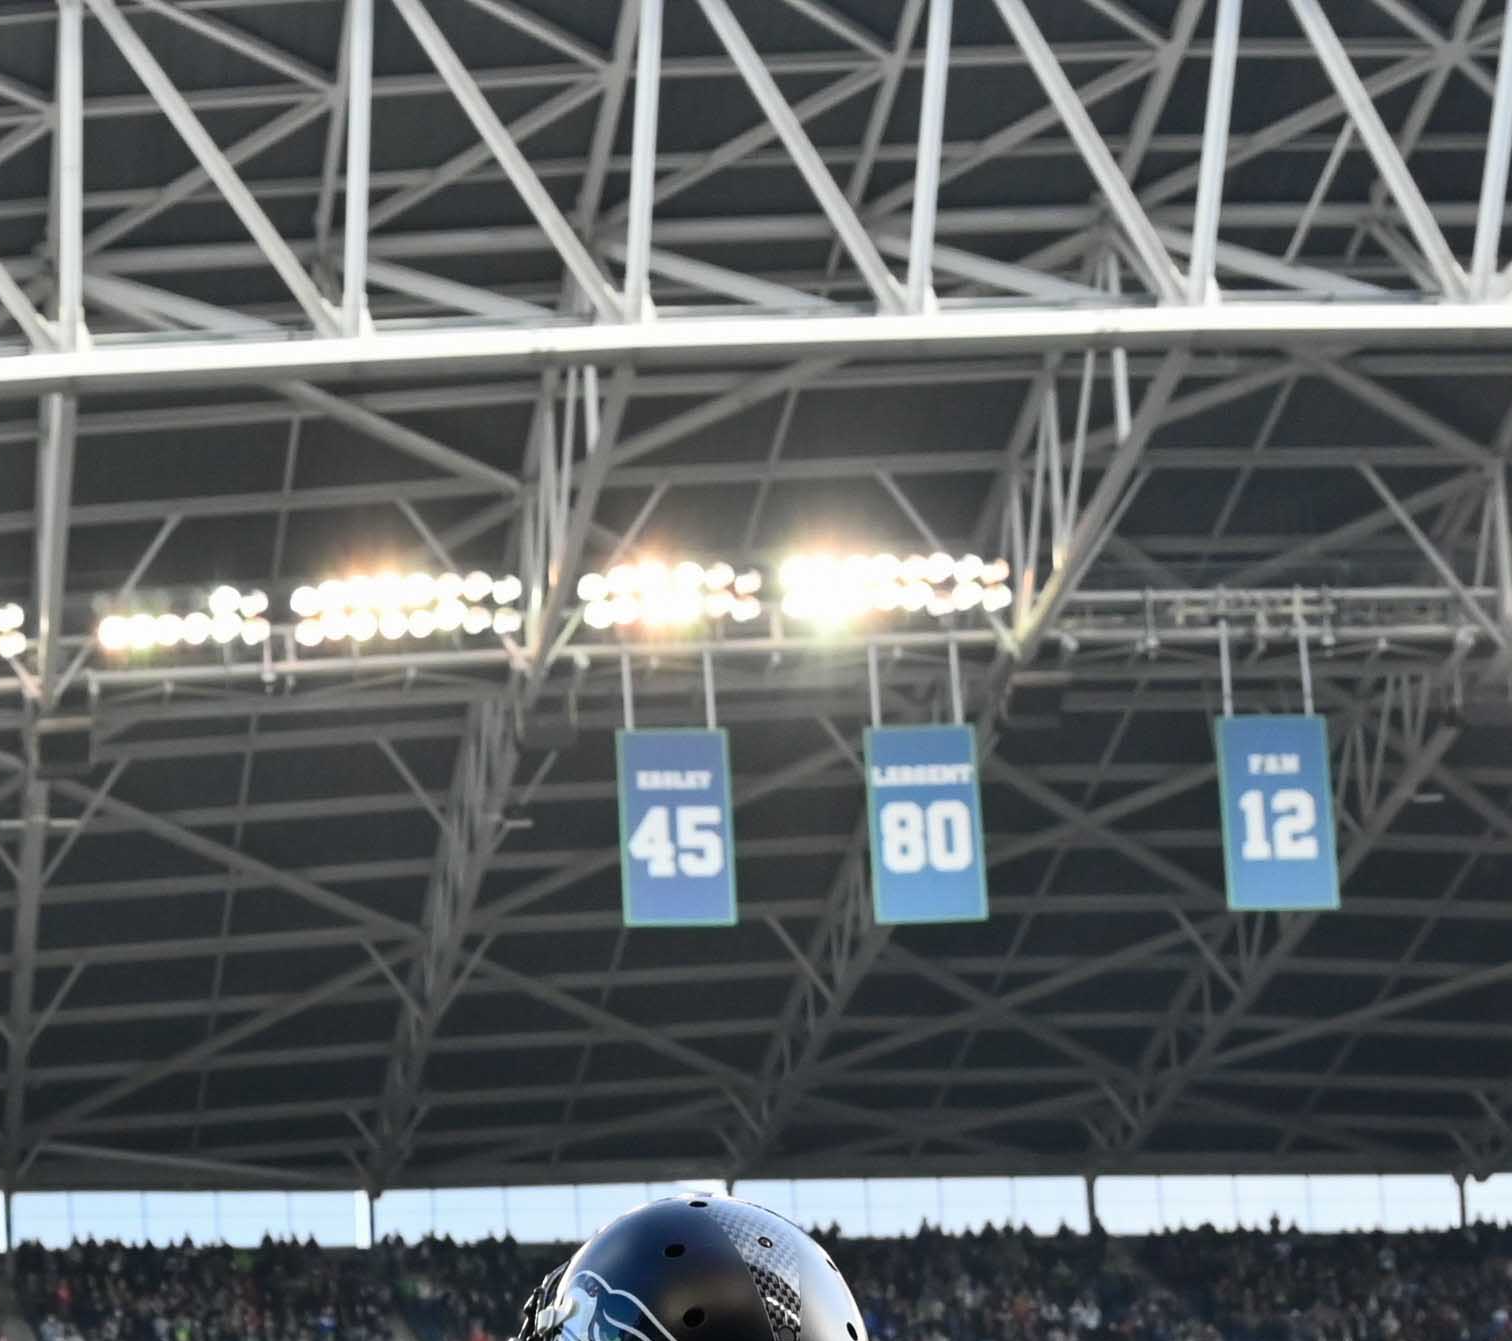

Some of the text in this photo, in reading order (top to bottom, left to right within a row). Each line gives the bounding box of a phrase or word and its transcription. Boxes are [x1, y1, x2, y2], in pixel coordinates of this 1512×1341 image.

[628, 805, 724, 878] 45
[879, 800, 972, 873] 80
[1239, 788, 1318, 861] 12
